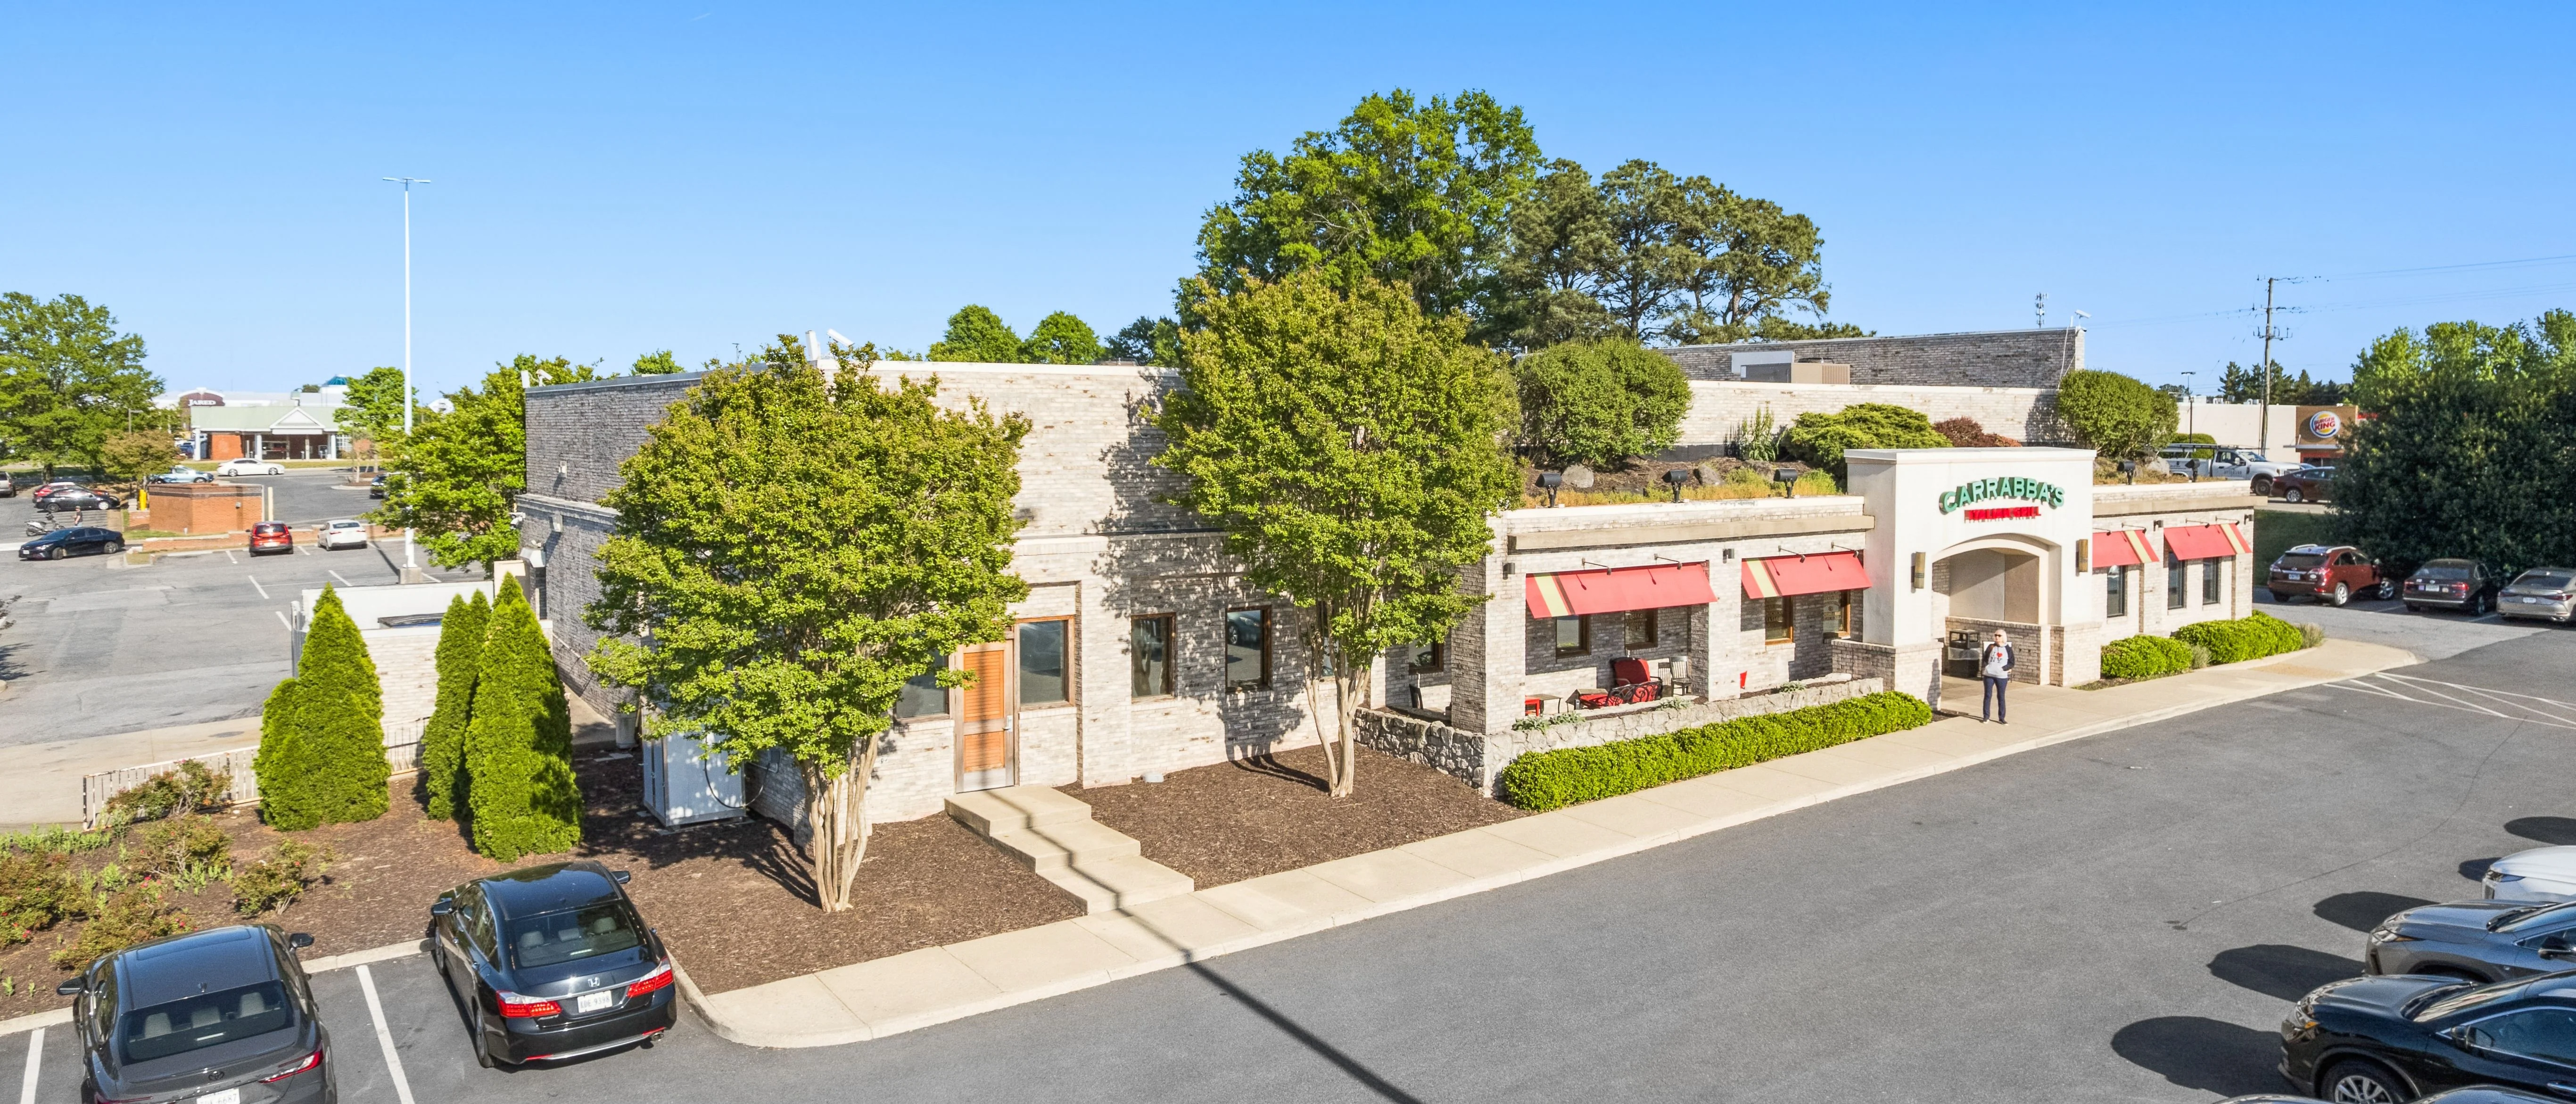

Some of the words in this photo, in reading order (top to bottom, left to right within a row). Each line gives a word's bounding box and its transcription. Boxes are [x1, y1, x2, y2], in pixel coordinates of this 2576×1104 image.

[2314, 417, 2335, 425] BURGER
[2314, 421, 2336, 431] KING
[1939, 477, 2065, 514] CARRABBA'S
